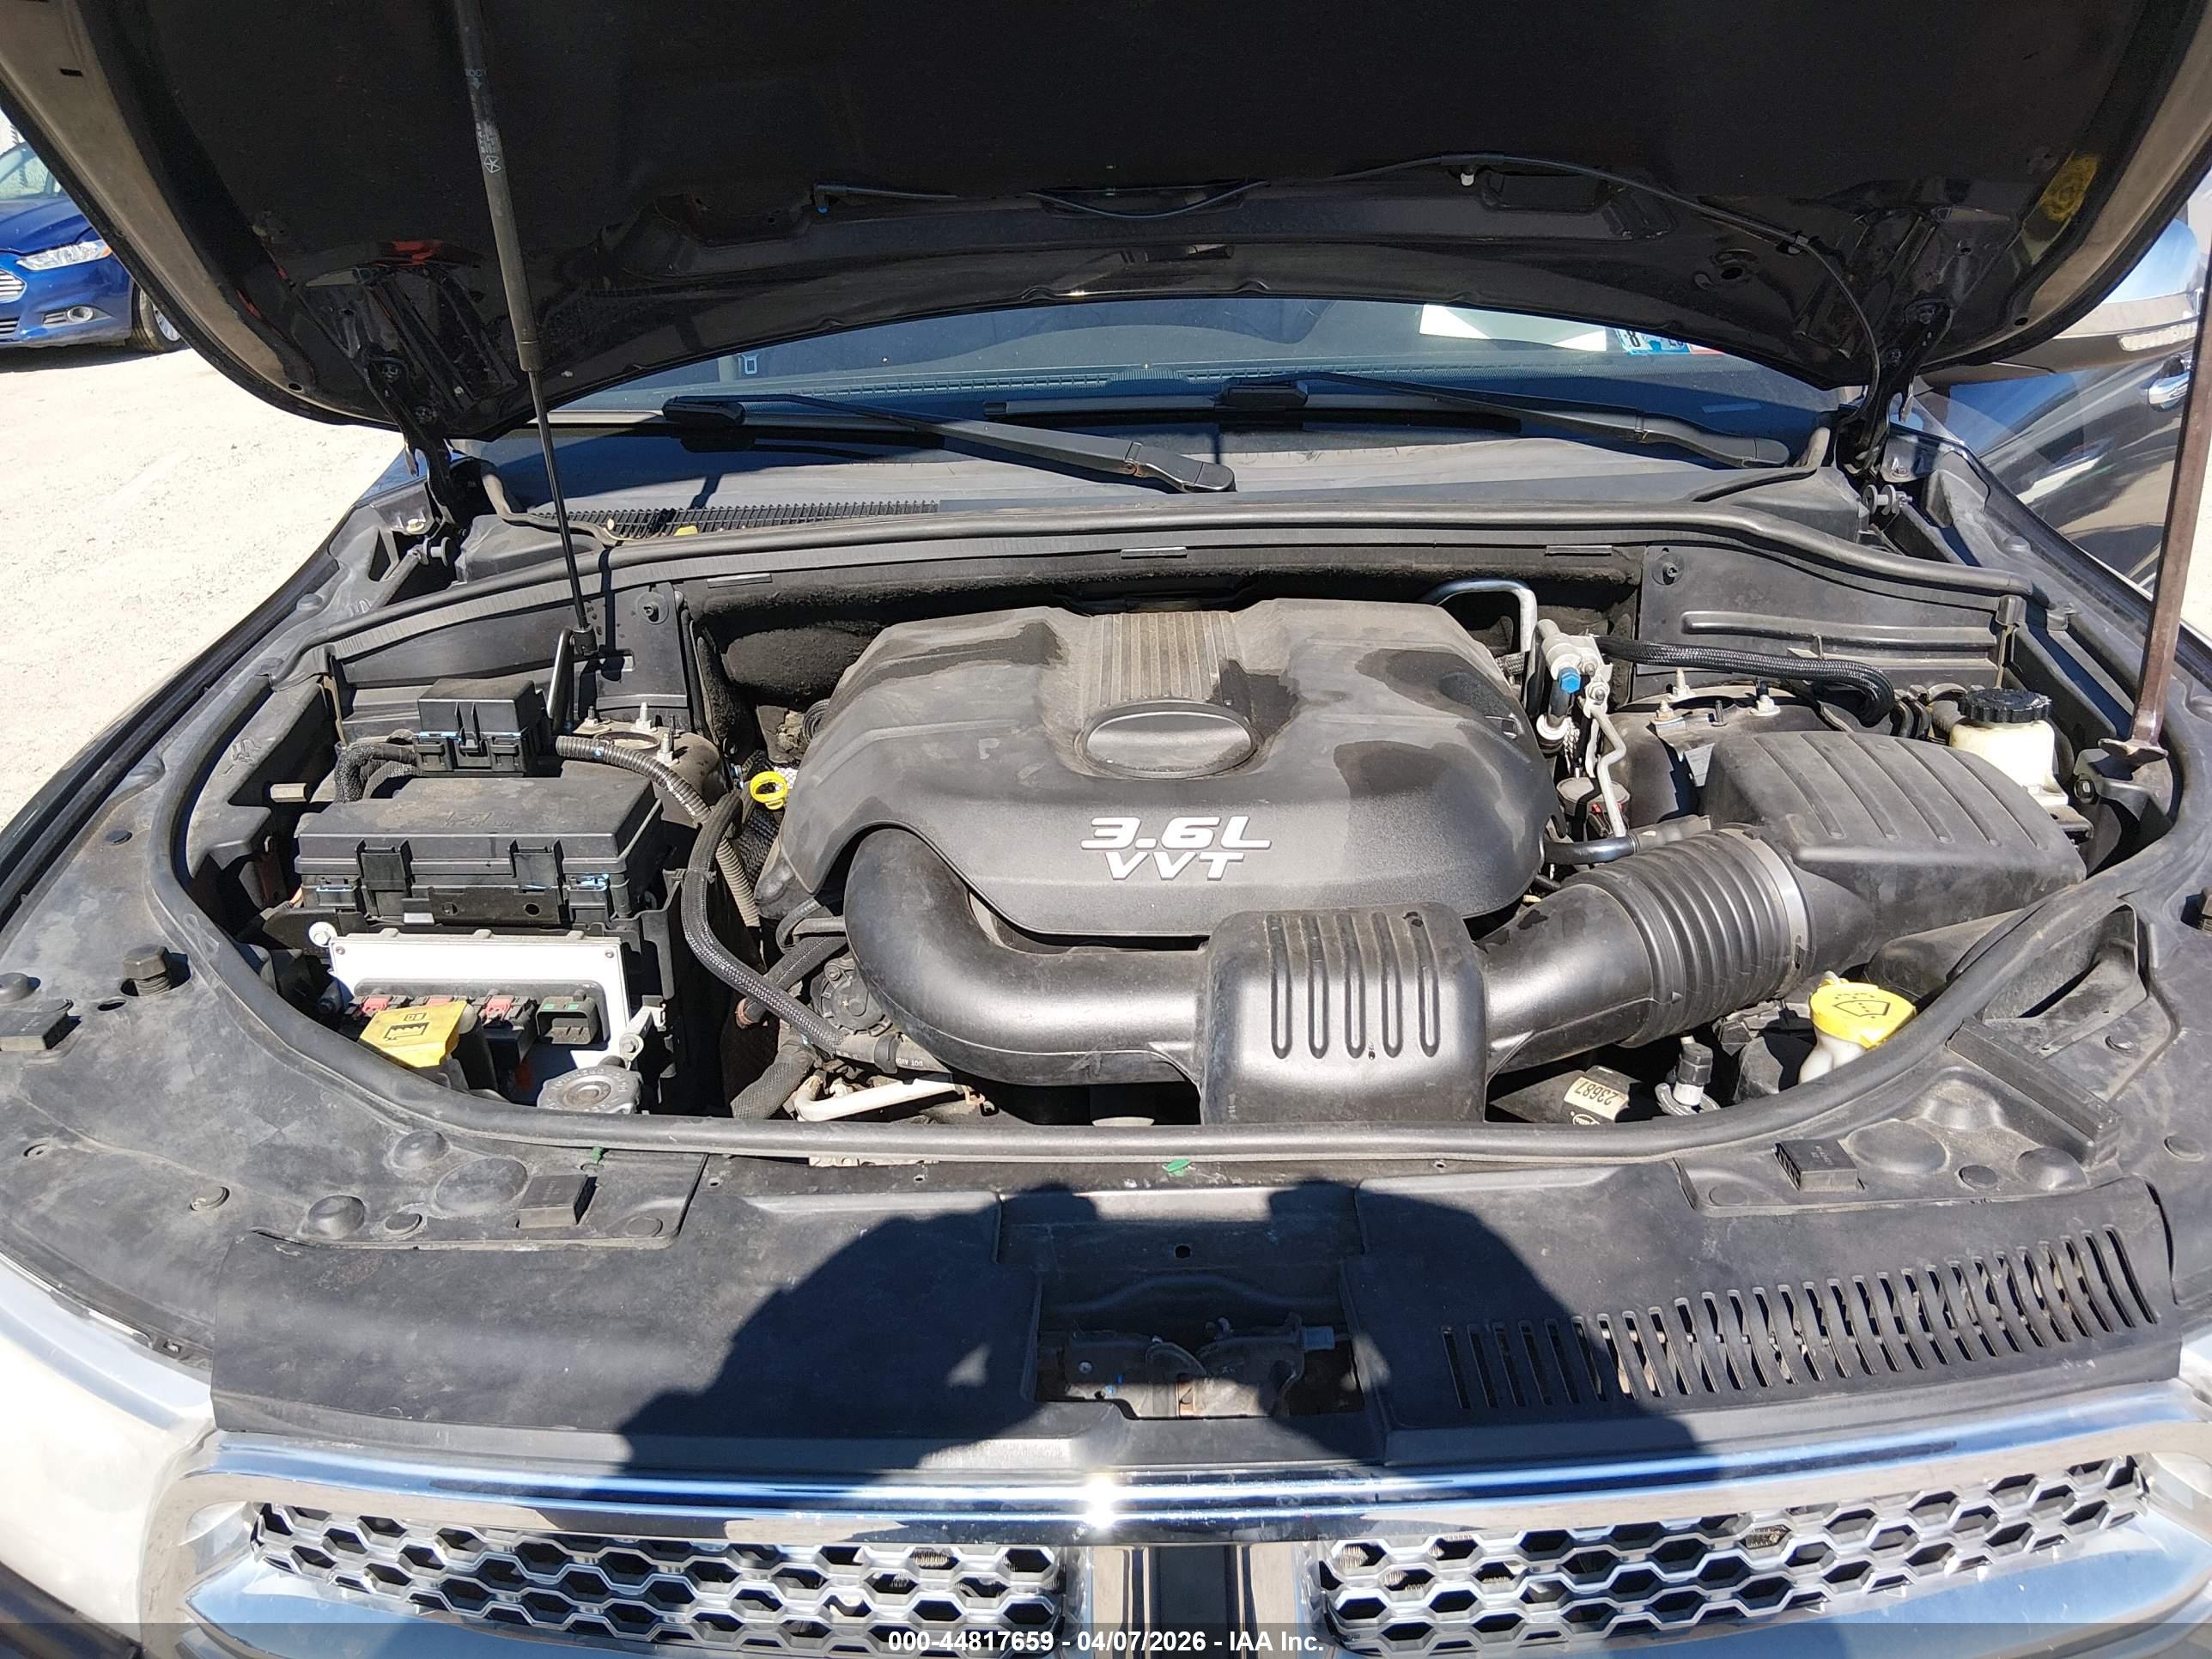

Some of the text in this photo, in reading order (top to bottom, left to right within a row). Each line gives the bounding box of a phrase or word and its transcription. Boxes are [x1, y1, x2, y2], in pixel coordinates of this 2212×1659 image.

[1080, 816, 1273, 850] 3.6L
[1104, 851, 1245, 881] VVT
[1573, 1080, 1620, 1106] 23687
